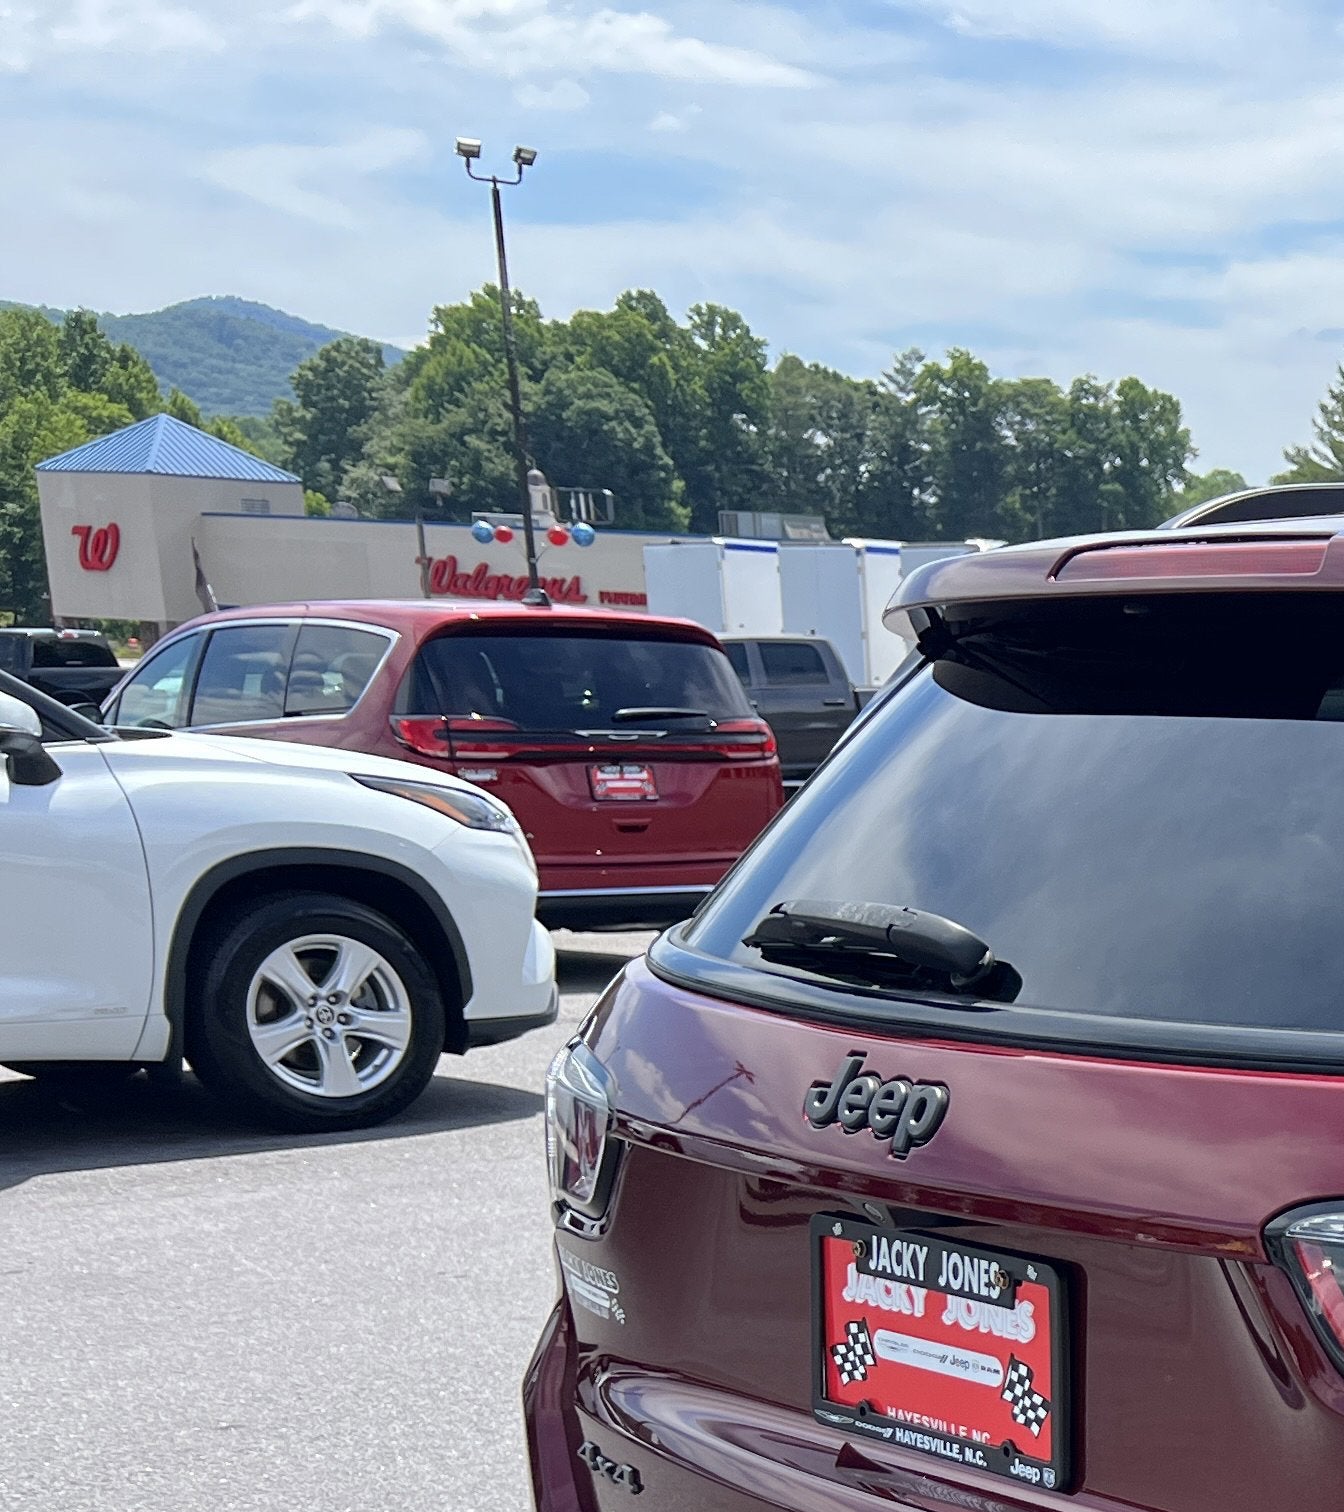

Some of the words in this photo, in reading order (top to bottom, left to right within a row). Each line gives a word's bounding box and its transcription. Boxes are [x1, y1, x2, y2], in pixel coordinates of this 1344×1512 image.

[72, 522, 120, 572] W
[805, 1051, 950, 1160] Jeep
[868, 1234, 929, 1281] JACKY
[937, 1250, 1002, 1299] JONES
[949, 1354, 970, 1372] Jeep
[576, 1441, 645, 1495] 4x4
[894, 1426, 964, 1462] HAYESVILLE,
[963, 1446, 988, 1467] N.C.
[1009, 1457, 1042, 1484] Jeep
